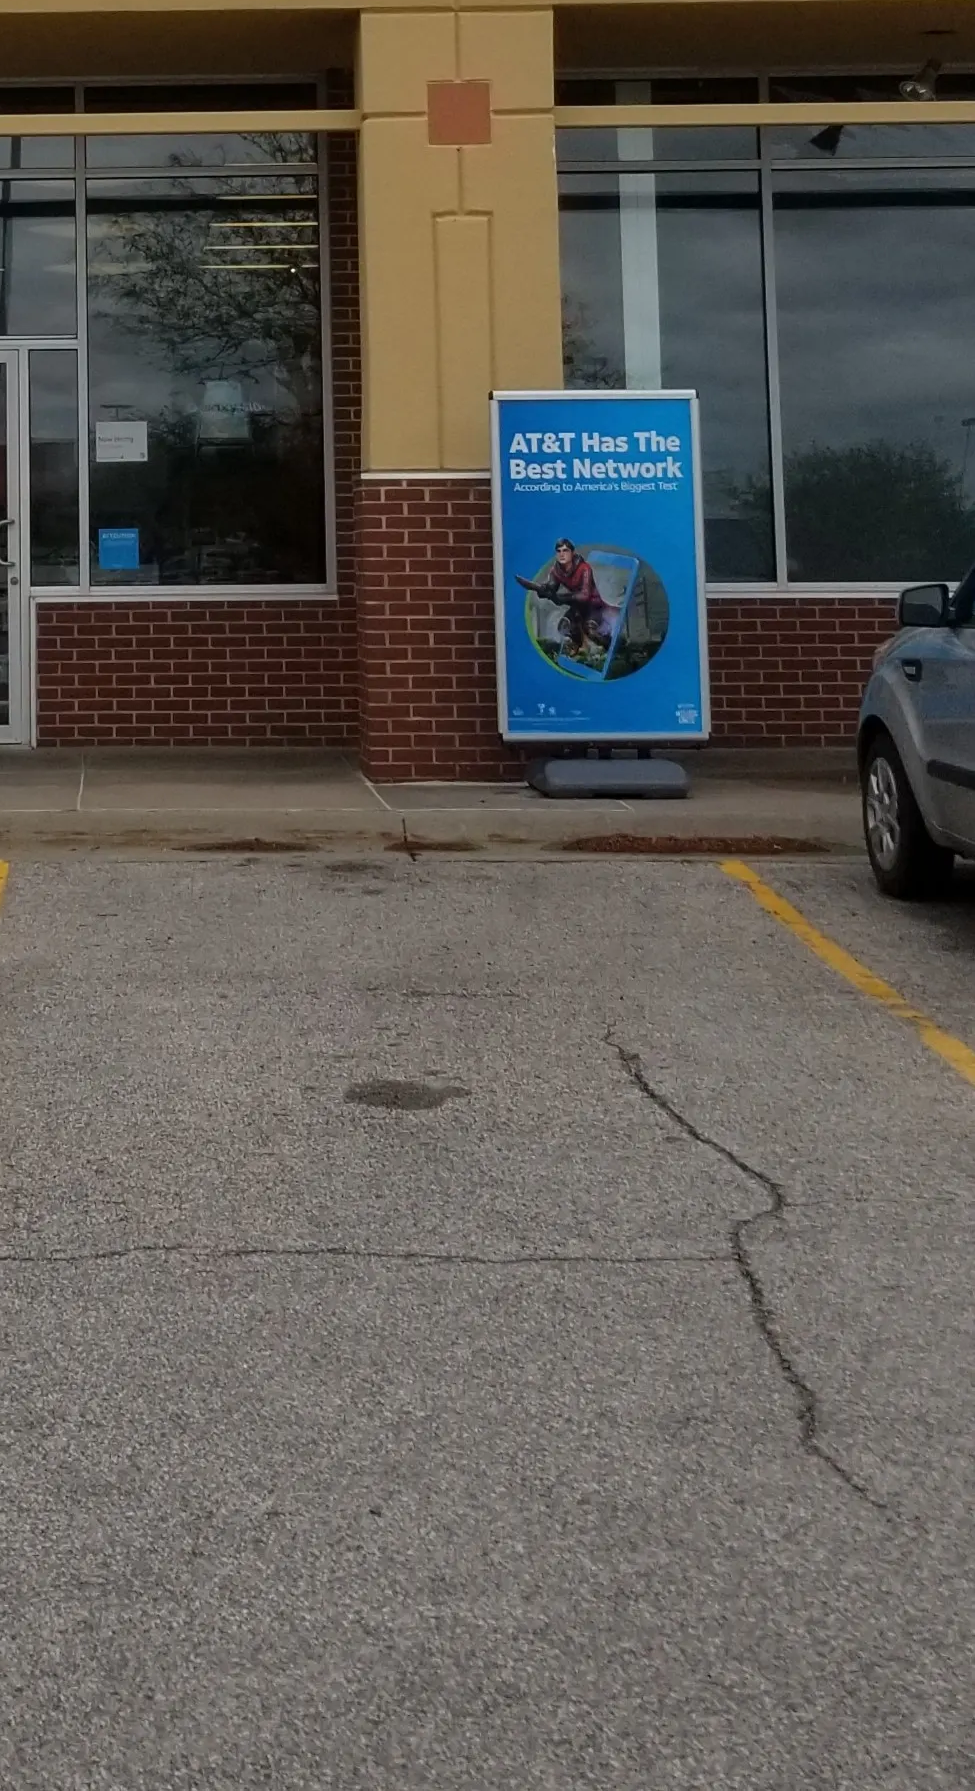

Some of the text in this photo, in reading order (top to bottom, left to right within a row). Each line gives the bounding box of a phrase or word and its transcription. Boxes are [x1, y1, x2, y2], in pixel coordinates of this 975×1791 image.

[509, 430, 681, 453] AT&T Has The
[509, 456, 684, 479] Best Network
[513, 481, 678, 493] According to America's Biggest Test
